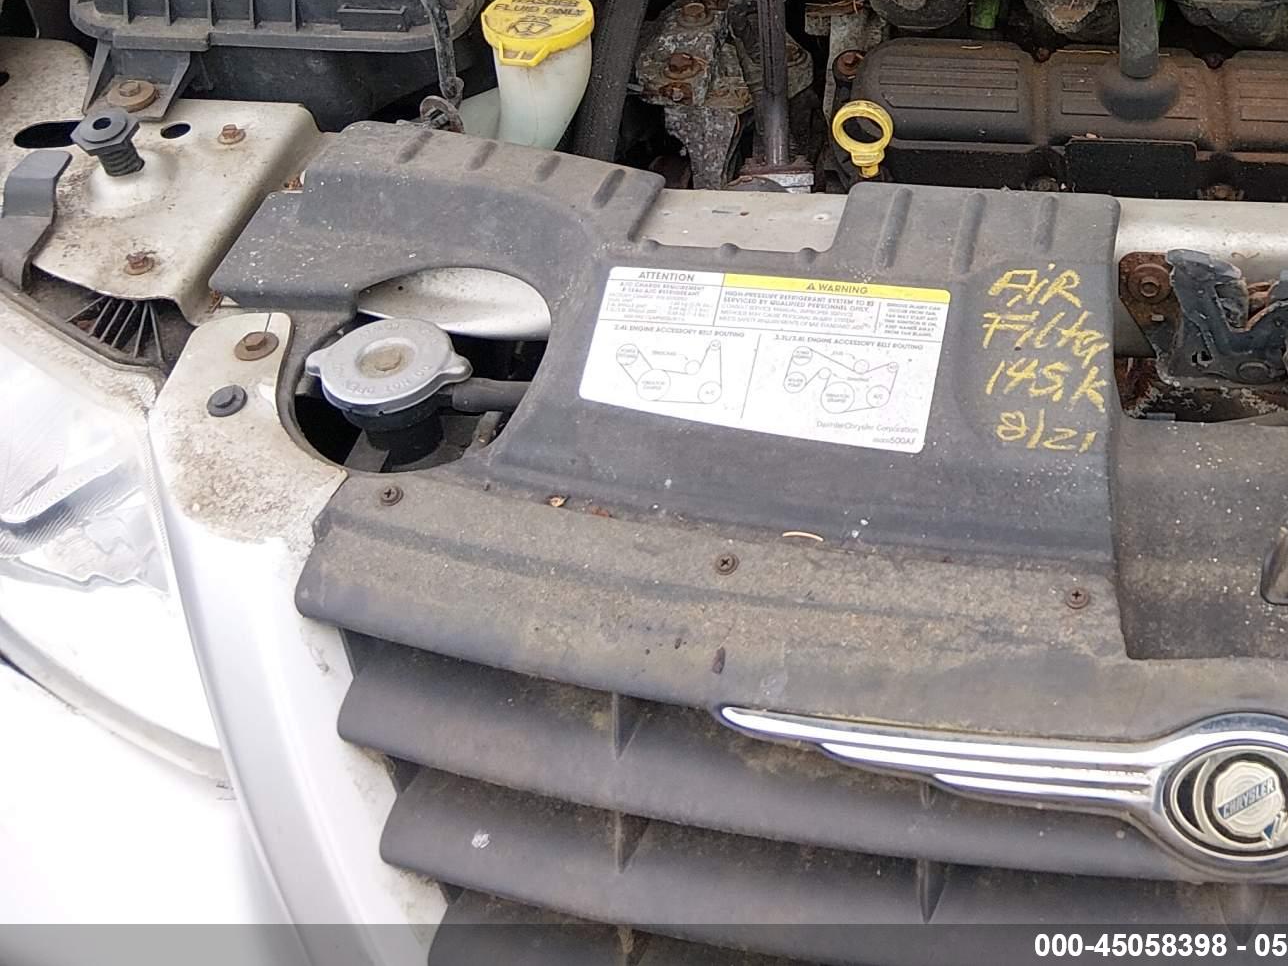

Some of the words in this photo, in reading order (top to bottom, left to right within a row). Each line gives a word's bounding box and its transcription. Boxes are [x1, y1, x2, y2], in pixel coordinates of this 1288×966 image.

[493, 3, 540, 14] FLUID
[544, 7, 586, 17] ONLY
[638, 271, 696, 282] ATTENTION
[818, 283, 869, 294] WARNING
[629, 325, 655, 333] ENGINE
[655, 326, 697, 335] ACCESSORY
[714, 330, 745, 338] ROUTING
[833, 338, 875, 347] ACCESSORY
[892, 342, 924, 350] ROUTING
[1223, 776, 1276, 820] CHRYSLER
